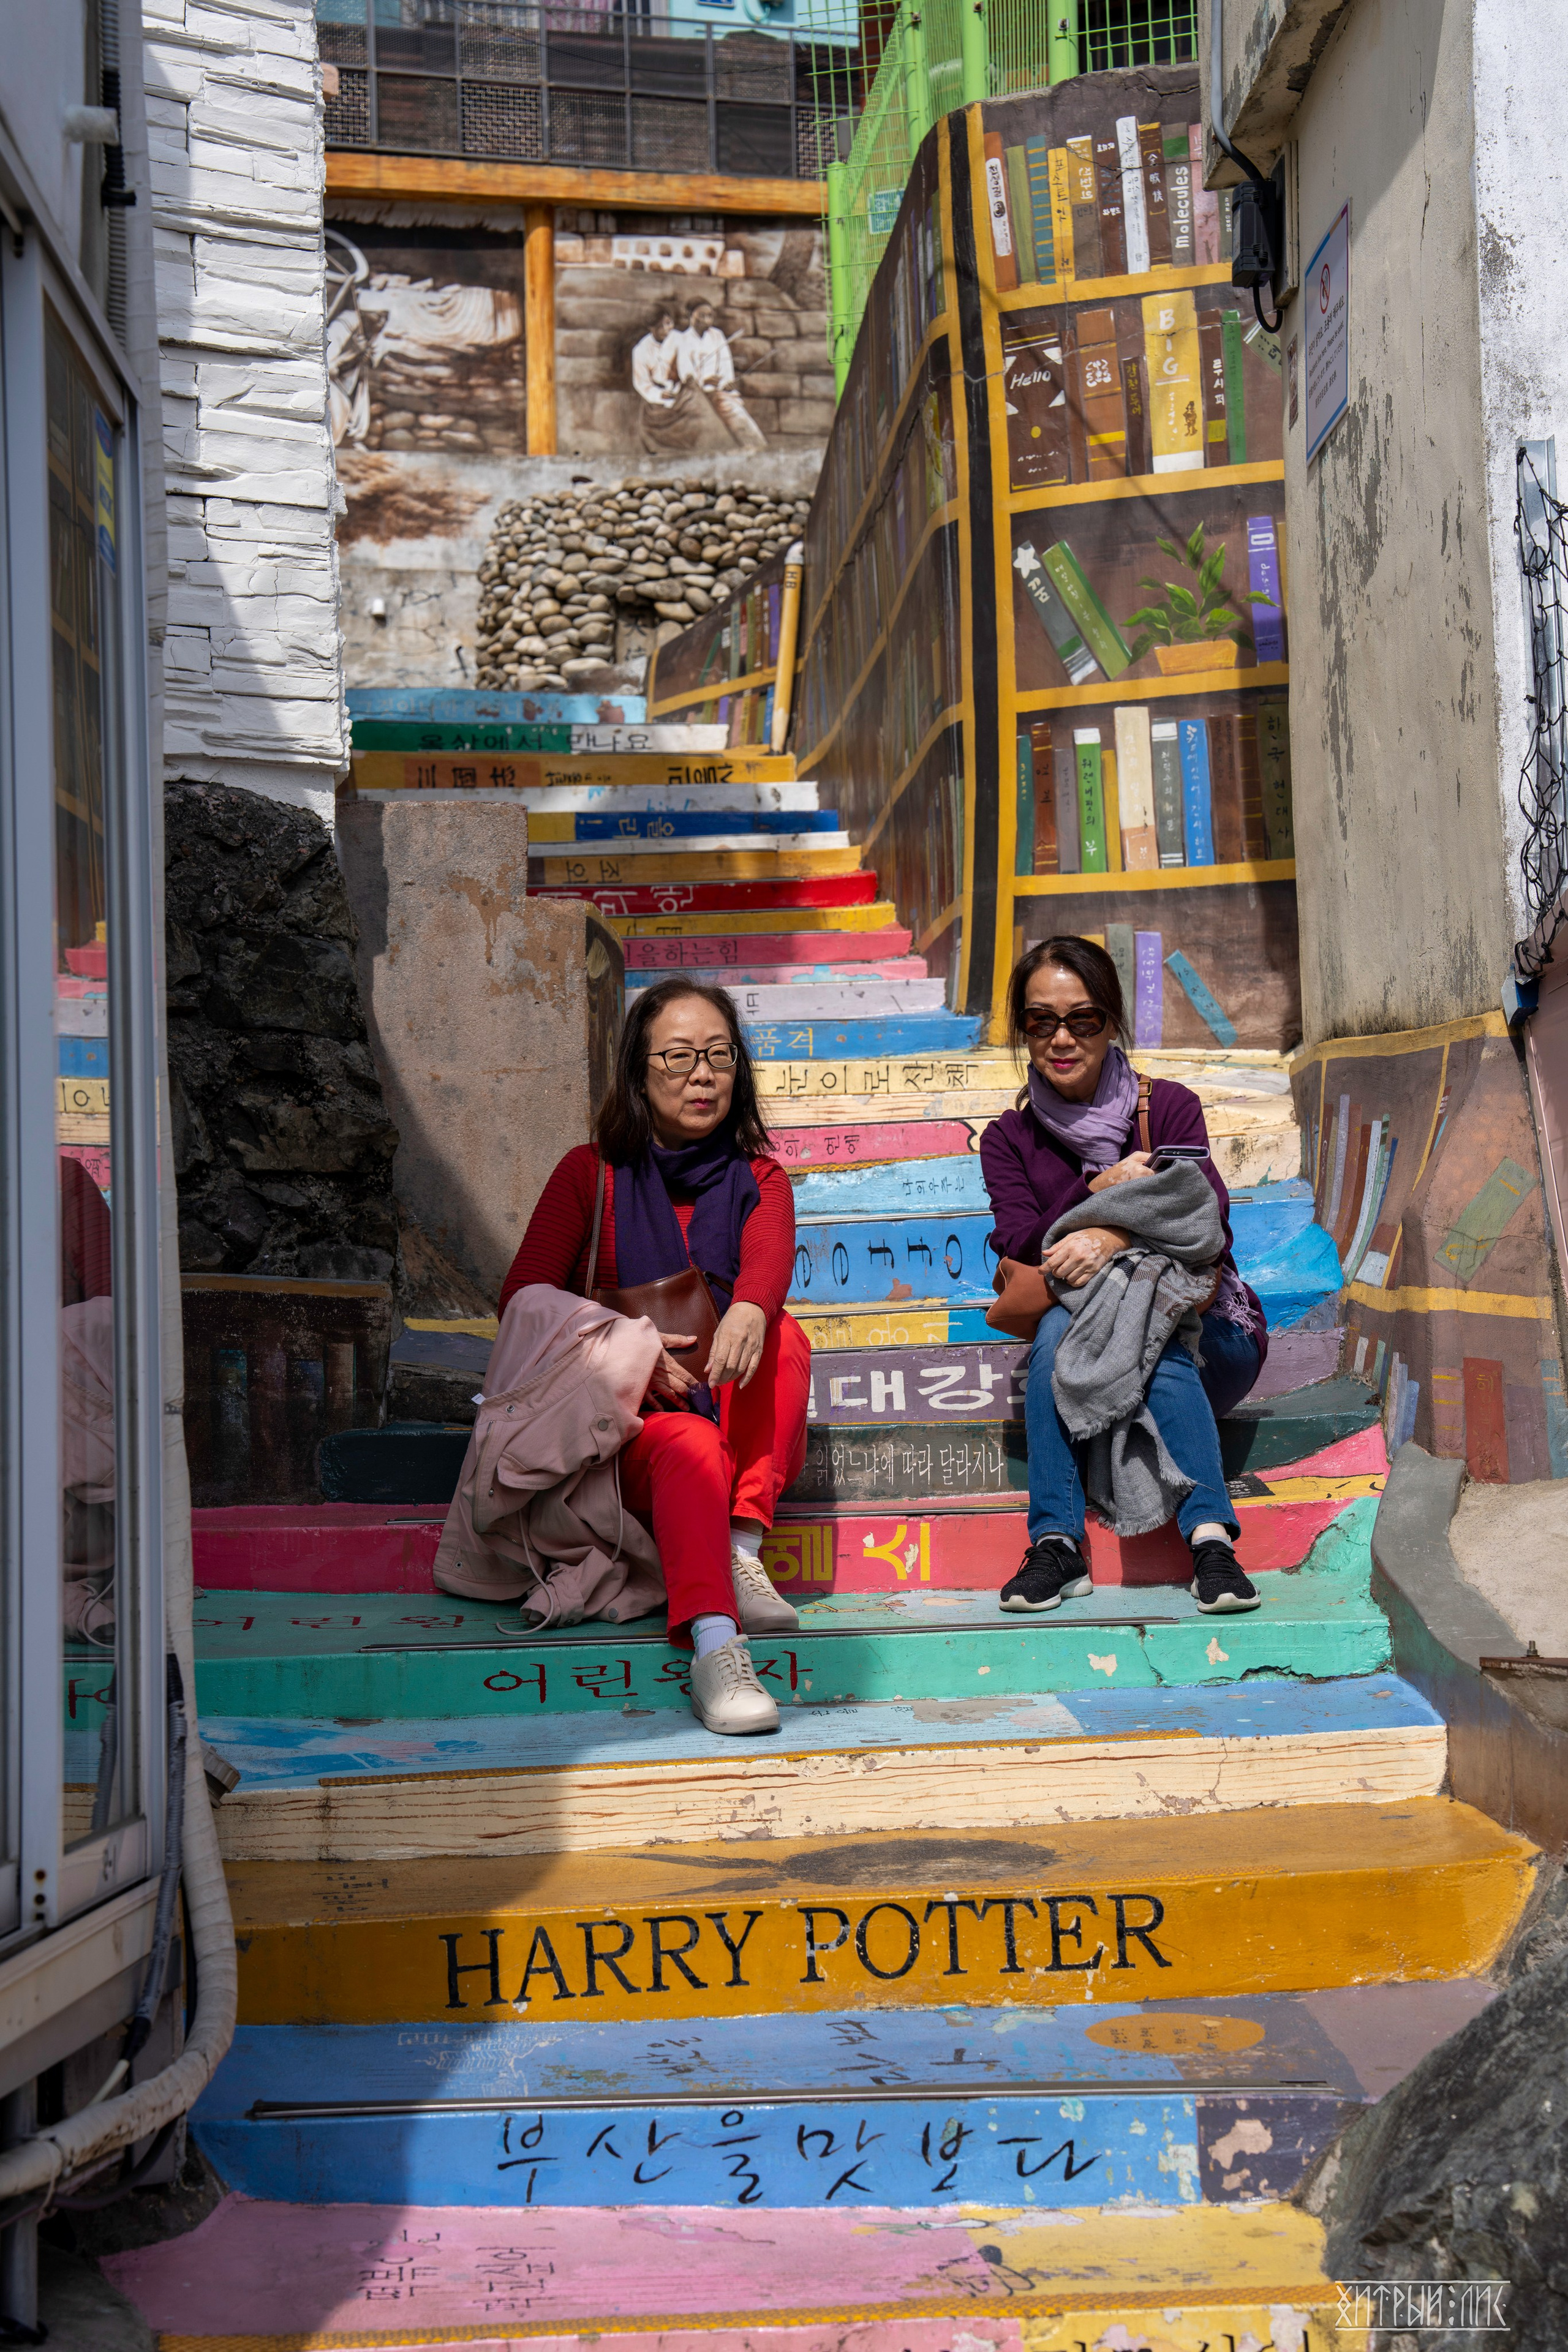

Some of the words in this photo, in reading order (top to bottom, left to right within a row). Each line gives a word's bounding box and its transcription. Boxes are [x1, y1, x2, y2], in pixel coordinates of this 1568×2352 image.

[1170, 165, 1190, 249] molecules
[1159, 309, 1178, 375] BIG
[1010, 370, 1052, 390] Hello
[784, 571, 796, 589] HB
[1085, 840, 1098, 856] 부
[753, 1027, 814, 1058] 품격
[824, 1134, 861, 1156] 연애
[438, 1910, 764, 2008] HARRY
[796, 1893, 1173, 1985] POTTER
